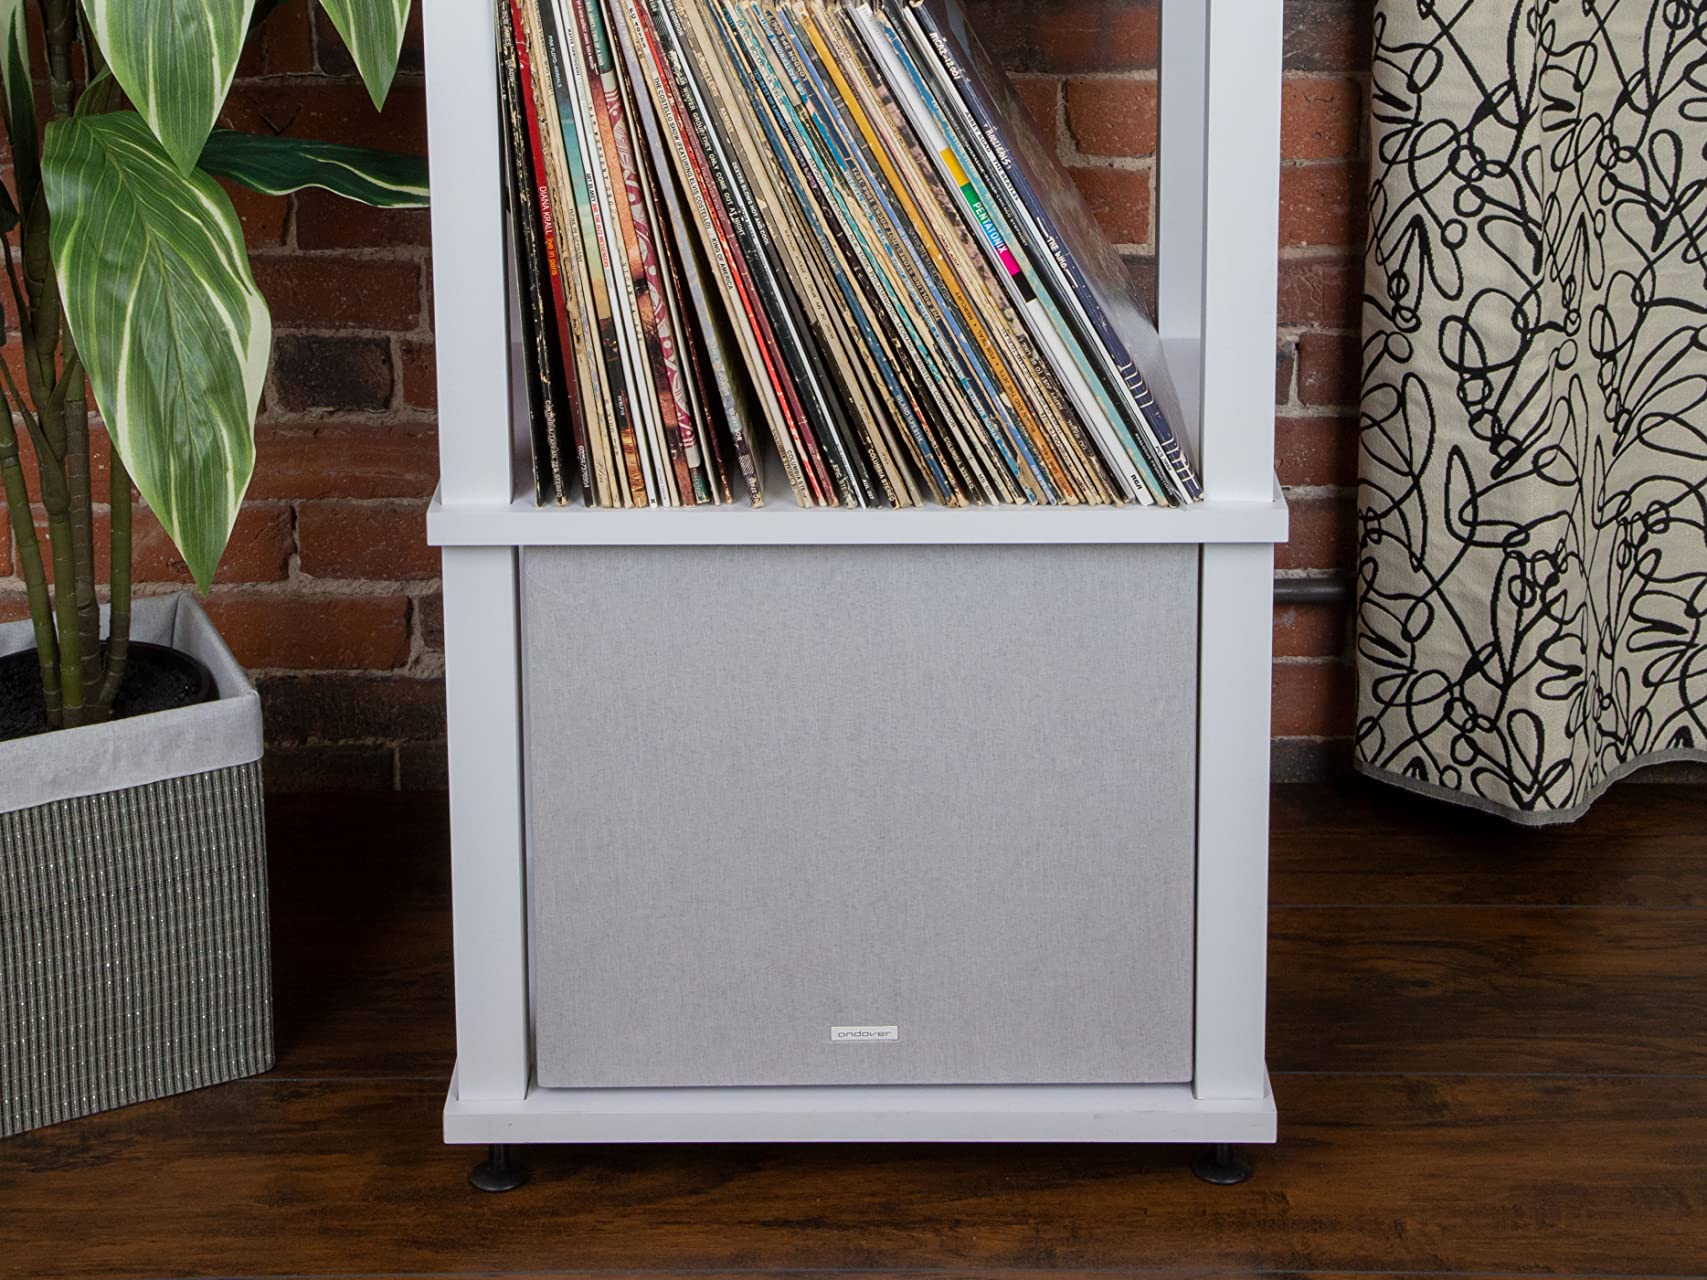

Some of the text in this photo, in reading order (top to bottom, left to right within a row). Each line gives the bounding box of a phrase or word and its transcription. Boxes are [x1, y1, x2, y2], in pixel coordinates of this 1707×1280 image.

[669, 10, 685, 36] GORDON
[780, 35, 792, 50] 2PS
[550, 47, 558, 63] FLOYD
[787, 50, 809, 82] LONDON
[928, 31, 962, 81] MCA2-12001
[553, 65, 562, 87] ANIMALS
[653, 77, 662, 89] THE
[681, 86, 697, 111] WINTER
[758, 79, 770, 96] BEST
[766, 95, 775, 106] OF
[658, 89, 673, 122] COSTELLO
[669, 122, 681, 142] SHOW
[963, 111, 1019, 201] ABBEY ROAD THE BEATLES
[984, 128, 1012, 166] HOOLIGANS
[675, 142, 694, 178] (FEATURING
[708, 153, 720, 171] ONLY
[689, 177, 700, 195] ELVIS
[715, 171, 728, 191] COME
[539, 186, 550, 210] DIANA
[723, 191, 734, 207] OUT
[731, 161, 745, 184] DEXTER
[740, 183, 753, 205] BLOWS
[749, 204, 759, 218] HOT
[754, 217, 763, 230] AND
[759, 229, 770, 246] COOL
[695, 195, 713, 230] COSTELLO)
[729, 206, 738, 216] AT
[871, 203, 890, 230] ROCKS
[543, 212, 553, 234] KRALL
[588, 183, 596, 202] BLAKEY
[598, 236, 609, 268] MESSENGERS
[733, 216, 746, 237] NIGHT
[970, 202, 1008, 254] PENTATONIX
[711, 237, 721, 253] KING
[1045, 236, 1068, 269] THE WHO
[549, 259, 558, 276] paris
[716, 253, 724, 262] OF
[719, 262, 735, 290] AMERICA
[911, 275, 933, 306] ROLLING
[929, 305, 942, 322] THE
[954, 290, 975, 321] MERCURY
[848, 233, 860, 248] NEW
[858, 251, 871, 269] YORK
[932, 390, 957, 428] CONDUCTOR
[986, 347, 997, 361] FOR
[998, 369, 1010, 385] JETS
[1035, 366, 1044, 376] TO
[1007, 385, 1018, 398] THE
[1041, 375, 1053, 391] JUST
[894, 394, 911, 416] ISLAND
[1014, 398, 1025, 412] AND
[1050, 391, 1063, 410] HAPPY
[1066, 418, 1081, 440] MAHAL
[1077, 439, 1087, 452] TAJ
[785, 450, 802, 481] COLUMBIA
[831, 463, 843, 479] EPIC
[941, 436, 976, 489] COLUMBIA STEREO
[1133, 432, 1173, 496] ANALOGUE PRODUCTIONS
[865, 448, 886, 479] COLUMBIA
[879, 478, 896, 502] STEREO
[1130, 473, 1143, 490] RCA
[838, 1030, 892, 1038] andover
